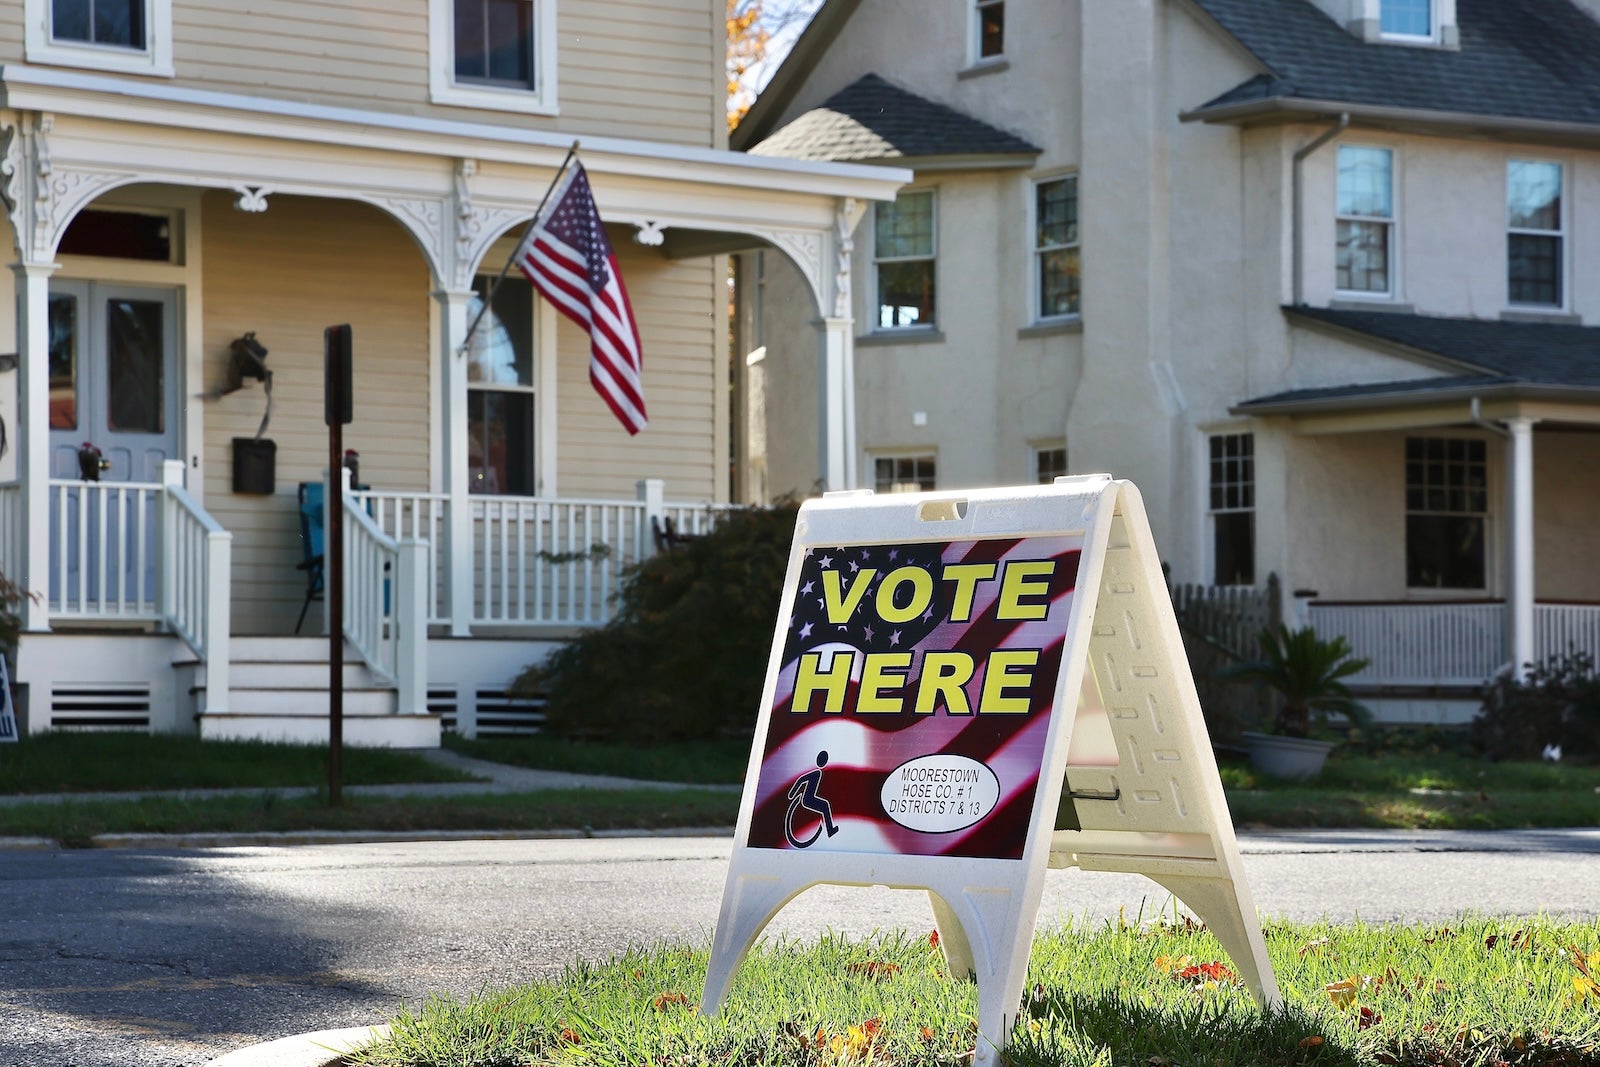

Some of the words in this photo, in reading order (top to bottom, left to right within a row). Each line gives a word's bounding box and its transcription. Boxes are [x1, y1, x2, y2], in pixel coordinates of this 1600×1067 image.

[820, 560, 1057, 625] VOTE
[789, 649, 1041, 715] HERE
[901, 768, 980, 783] MOORESTOWN
[902, 784, 933, 798] HOSE
[935, 785, 954, 799] CO.
[957, 785, 965, 799] #
[967, 786, 972, 799] 1
[889, 799, 946, 815] DISTRICTS
[950, 801, 956, 815] 7
[957, 801, 965, 815] &
[969, 801, 981, 816] 13
